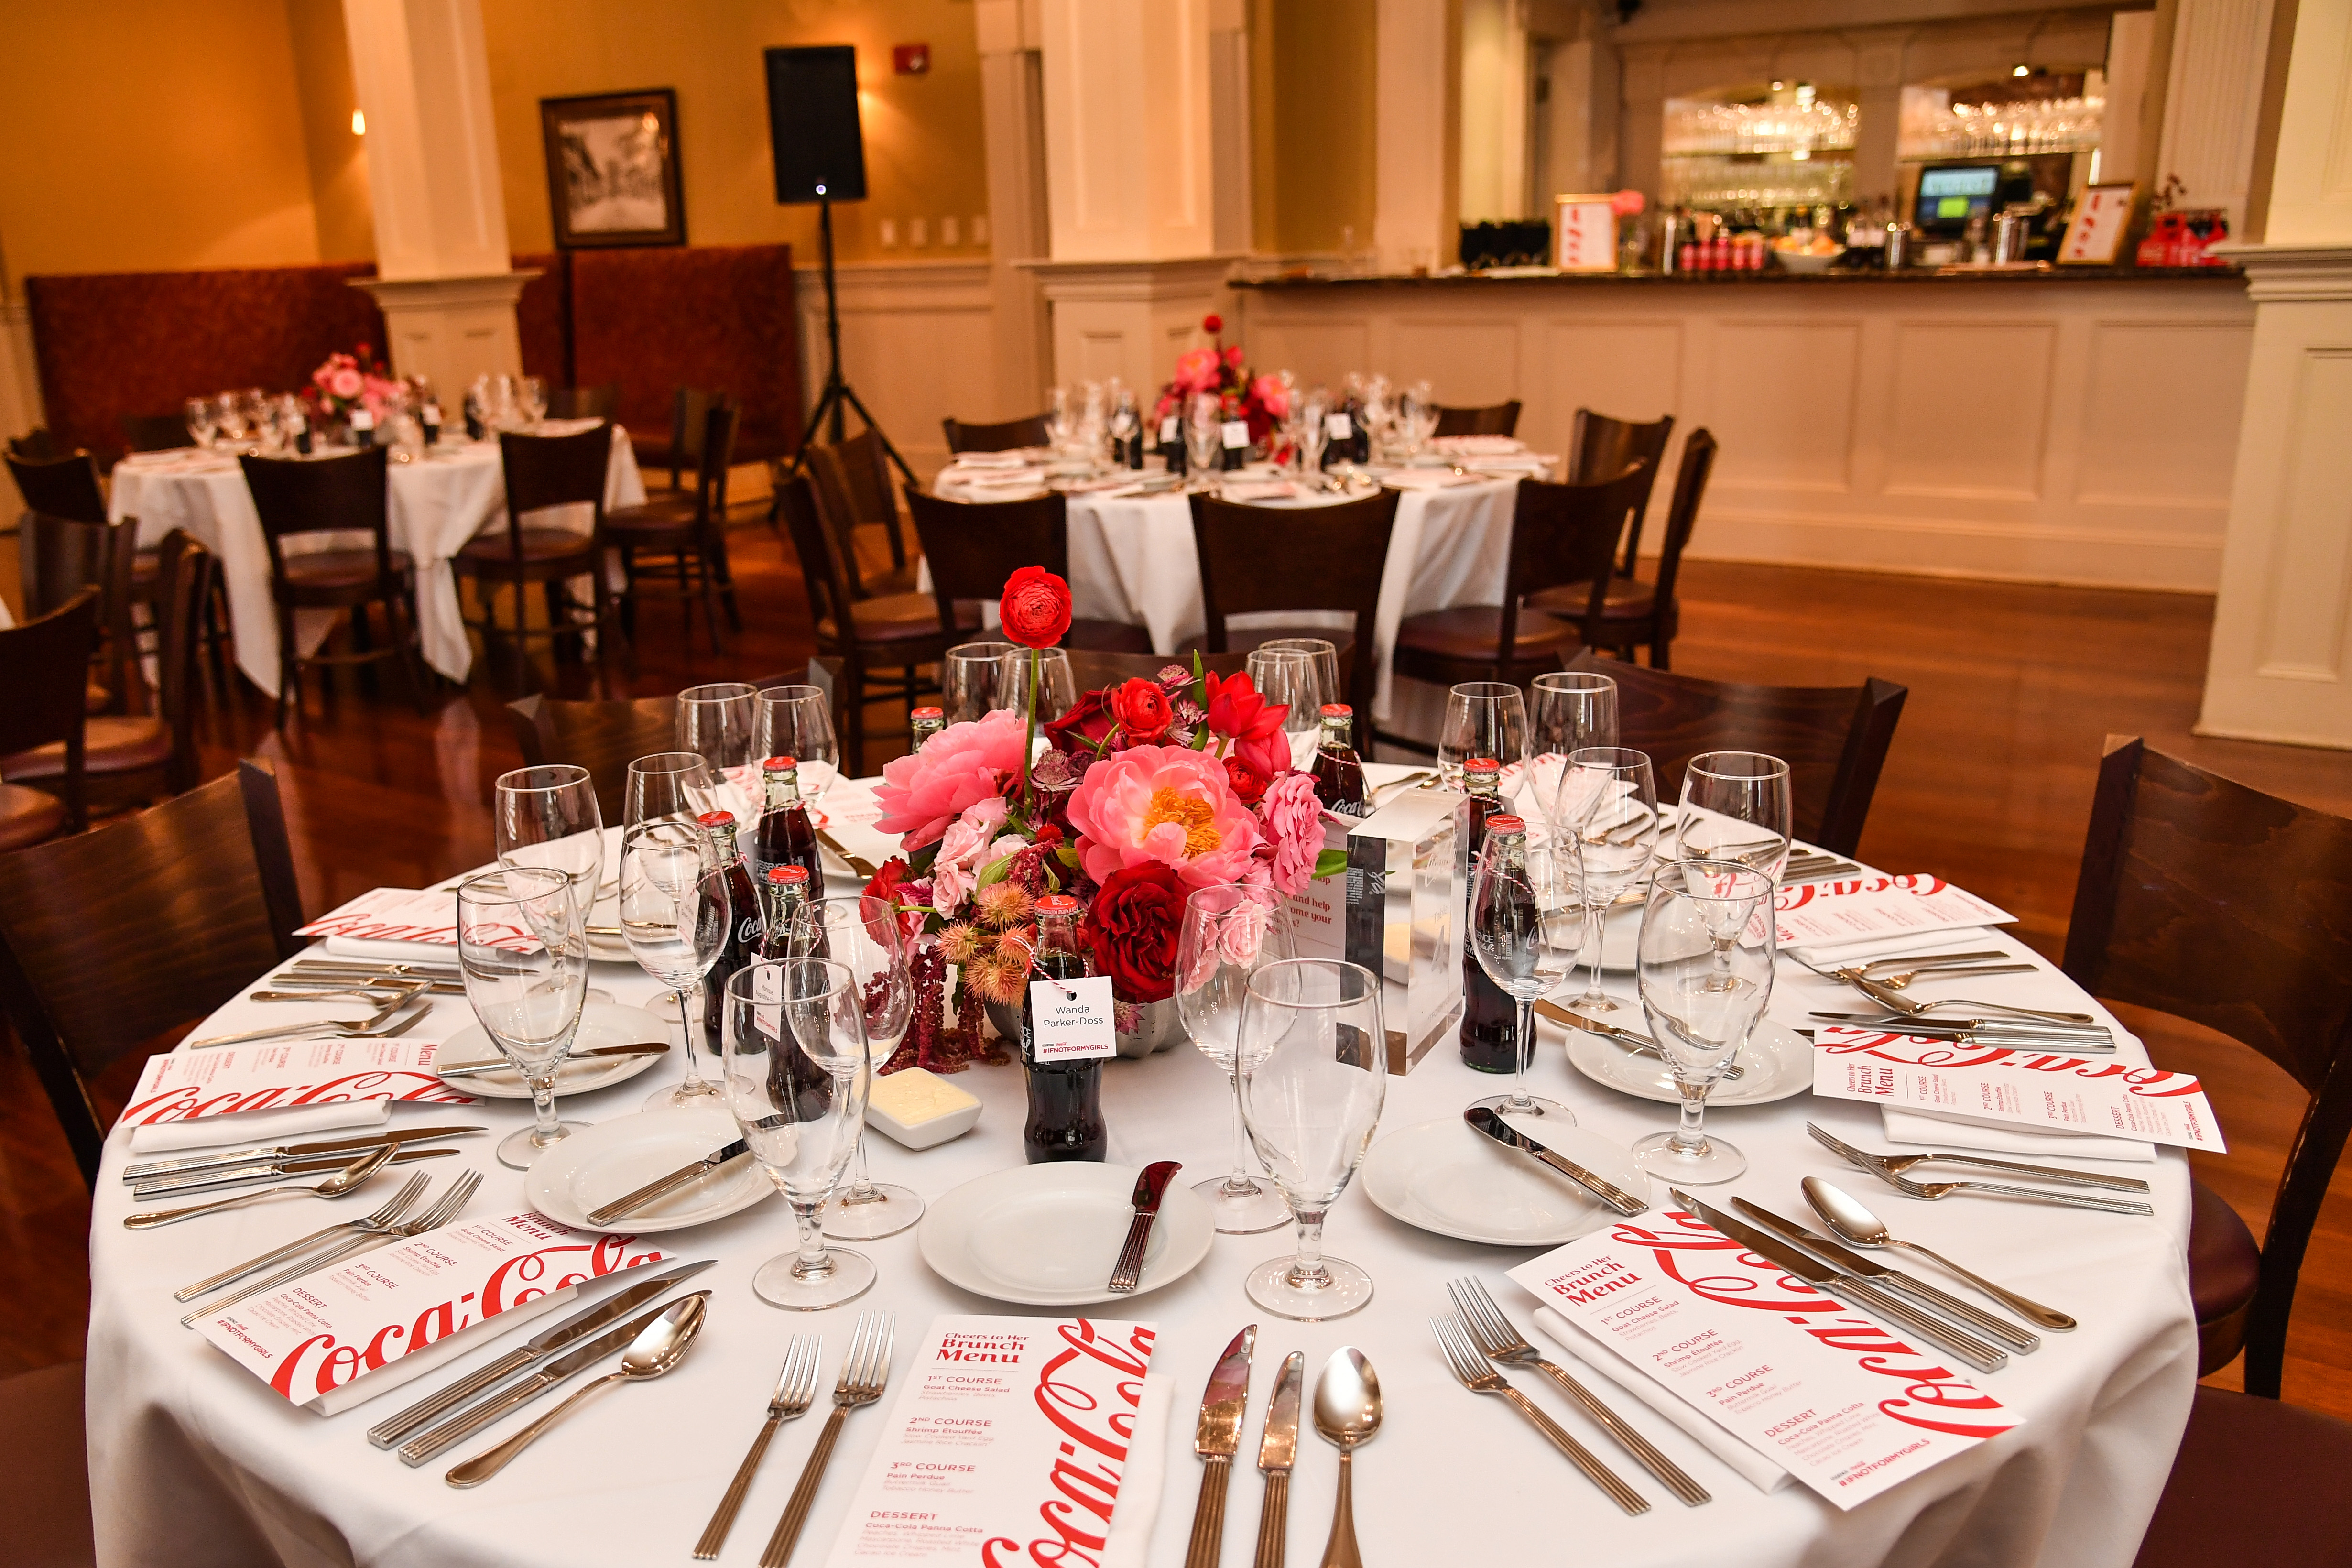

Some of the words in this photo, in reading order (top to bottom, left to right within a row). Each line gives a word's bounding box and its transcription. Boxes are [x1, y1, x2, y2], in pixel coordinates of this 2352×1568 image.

[1292, 894, 1310, 905] and
[1312, 898, 1330, 912] help
[1311, 912, 1332, 924] your
[1055, 1005, 1090, 1014] Wanda
[1044, 1017, 1104, 1028] Parker-Doss
[418, 1043, 438, 1066] Menu
[1043, 1044, 1109, 1054] #IFNOTFORMYGIRLS
[1847, 1063, 1855, 1071] Her
[1847, 1077, 1855, 1092] Cheers
[1857, 1065, 1872, 1094] Brunch
[1875, 1068, 1894, 1096] Menu
[1918, 1075, 1927, 1095] COURSE
[1980, 1082, 1991, 1102] COURSE
[2043, 1091, 2056, 1111] COURSE
[2110, 1106, 2124, 1129] DESSERT
[501, 1216, 552, 1241] Menu
[521, 1212, 569, 1236] Brunch
[481, 1230, 513, 1246] COURSE
[426, 1249, 458, 1266] COURSE
[353, 1274, 371, 1286] Perdue
[366, 1270, 399, 1289] COURSE
[1545, 1270, 1581, 1286] Cheers
[1591, 1255, 1611, 1265] Her
[1553, 1263, 1624, 1295] Brunch
[293, 1288, 327, 1308] DESSERT
[1566, 1273, 1641, 1306] Menu
[270, 1234, 662, 1400] Coca-Cola
[280, 1293, 304, 1310] Coca-Cola
[303, 1308, 319, 1319] Panna
[317, 1318, 332, 1328] Cotta
[1600, 1316, 1612, 1325] 1ST
[1616, 1296, 1662, 1318] COURSE
[1612, 1322, 1632, 1332] Goat
[1631, 1310, 1658, 1323] Cheese
[1657, 1300, 1679, 1312] Salad
[217, 1319, 273, 1359] #IFNOTFORMYGIRLS
[942, 1339, 1024, 1350] Brunch
[1652, 1350, 1668, 1361] 2ND
[1671, 1329, 1718, 1352] COURSE
[936, 1349, 1019, 1363] Menu
[1664, 1354, 1691, 1368] Shrimp
[1690, 1340, 1723, 1355] Étouffée
[1706, 1386, 1722, 1397] 3RD
[1725, 1365, 1773, 1388] COURSE
[1718, 1395, 1737, 1405] Pain
[1736, 1383, 1764, 1396] Perdue
[934, 1418, 991, 1426] COURSE
[1764, 1409, 1816, 1437] DESSERT
[1778, 1424, 1818, 1445] Coca-Cola
[1817, 1413, 1842, 1425] Panna
[1841, 1402, 1864, 1413] Cotta
[915, 1463, 975, 1472] COURSE
[1839, 1439, 1929, 1486] #IFNOTFORMYGIRLS
[870, 1511, 937, 1520] DESSERT
